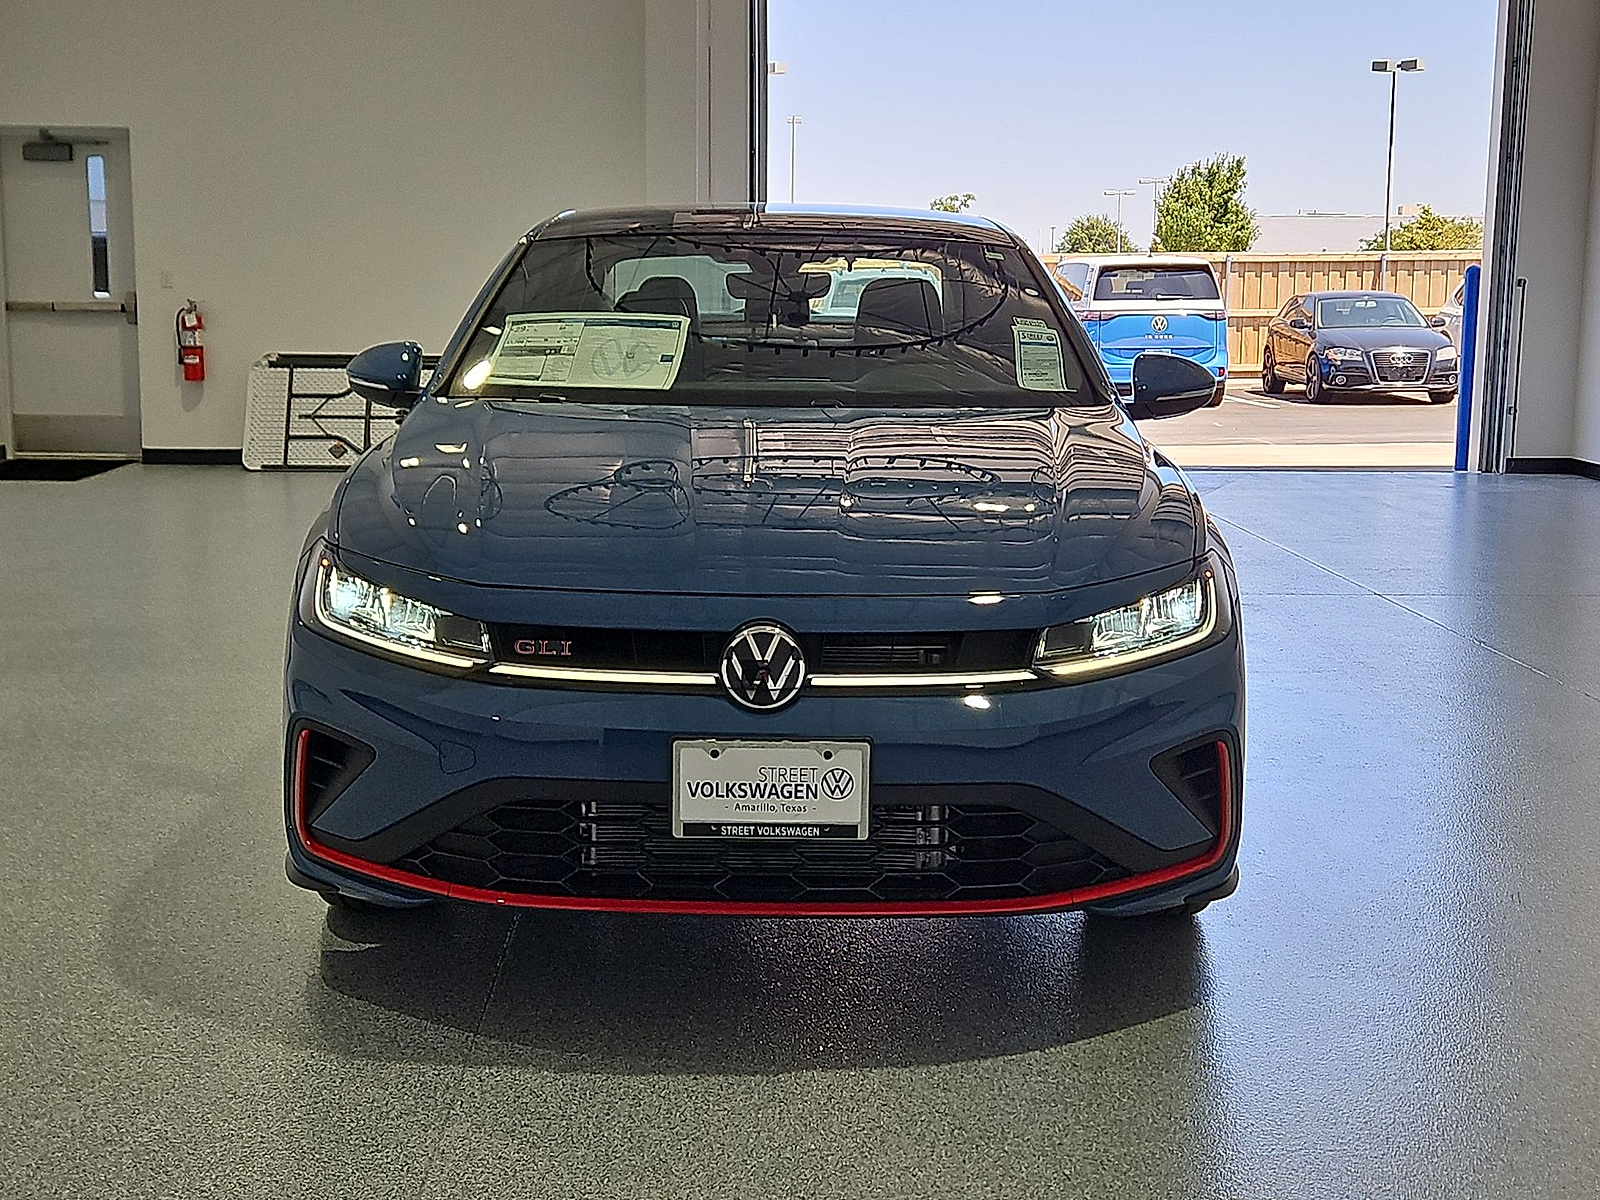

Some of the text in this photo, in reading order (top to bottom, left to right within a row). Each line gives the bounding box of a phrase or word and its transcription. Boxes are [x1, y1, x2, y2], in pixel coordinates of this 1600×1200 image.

[514, 639, 572, 656] GLI
[758, 767, 818, 782] STREET
[687, 781, 819, 800] VOLKSWAGEN
[734, 803, 807, 813] Amarillo, Texas
[721, 825, 820, 836] STREET VOLKSWAGEN
